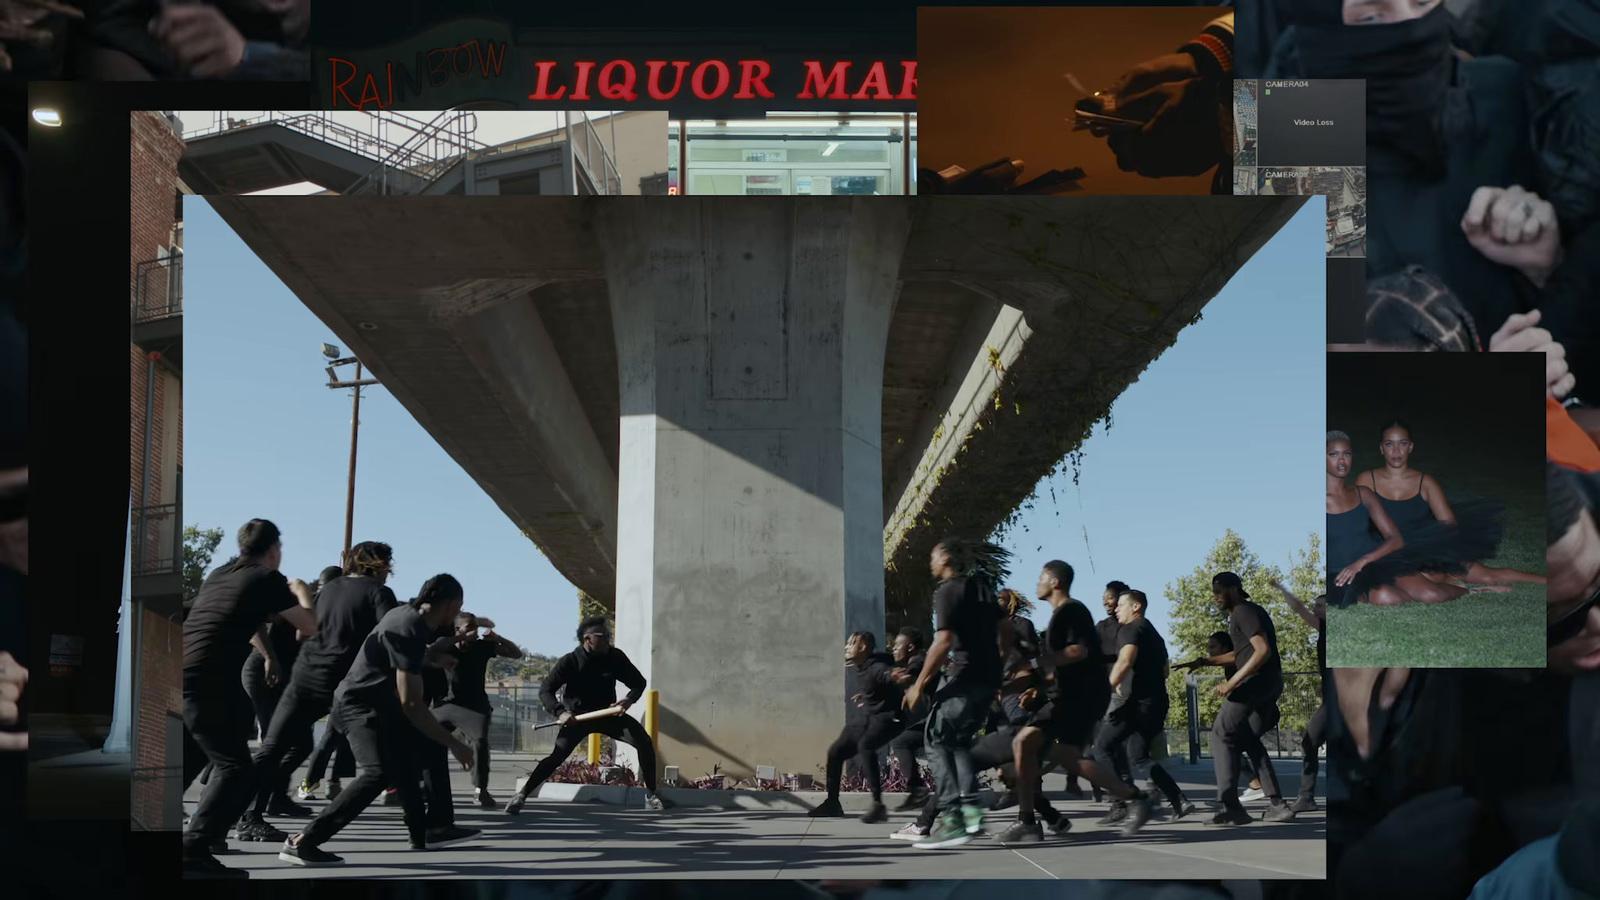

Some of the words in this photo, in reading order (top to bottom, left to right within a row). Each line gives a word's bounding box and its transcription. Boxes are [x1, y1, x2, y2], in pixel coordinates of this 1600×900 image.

[327, 36, 508, 110] RAINBOW
[528, 59, 776, 101] LIQUOR
[1265, 80, 1309, 88] CAMERA04
